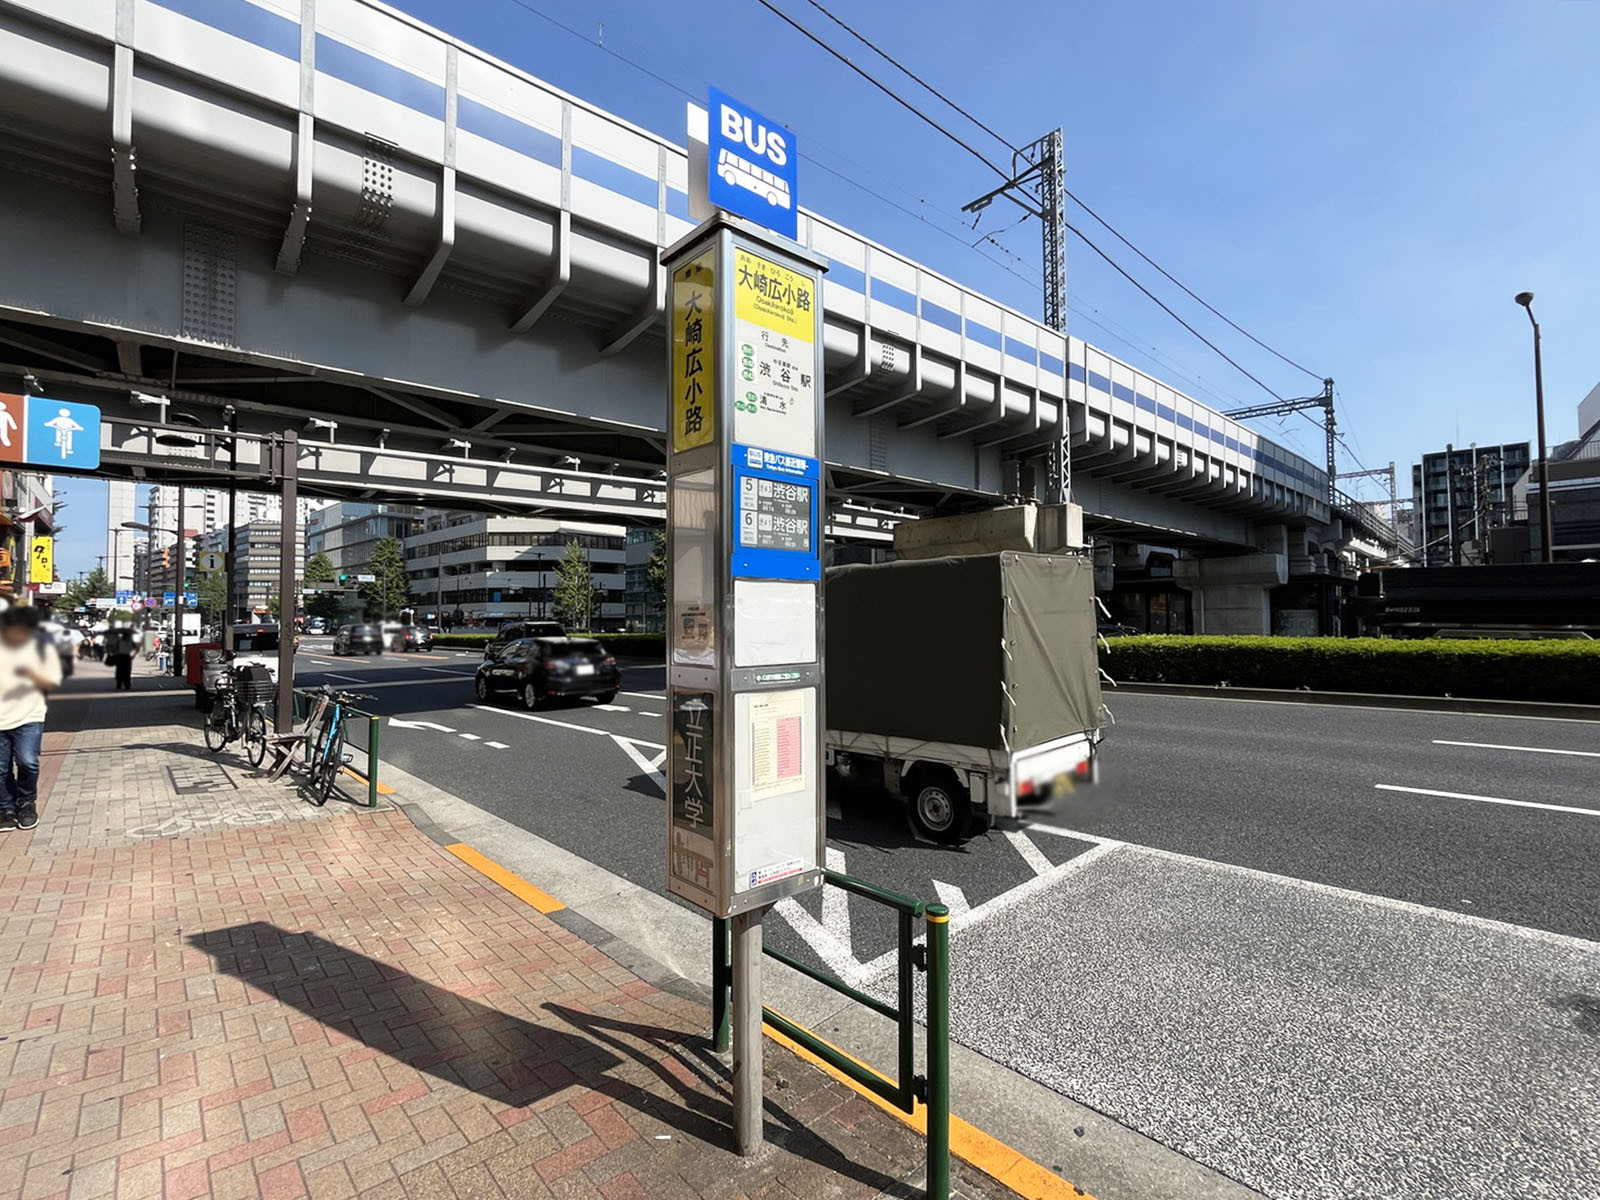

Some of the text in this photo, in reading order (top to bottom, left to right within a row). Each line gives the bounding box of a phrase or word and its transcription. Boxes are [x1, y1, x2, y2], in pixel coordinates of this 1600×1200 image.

[720, 103, 787, 166] BUS
[738, 264, 811, 312] 大崎広小路
[684, 290, 704, 437] 大崎広小路
[759, 361, 811, 389] 渋谷駅
[745, 478, 753, 491] 5
[773, 482, 809, 503] 渋谷駅
[745, 512, 753, 526] 6
[773, 516, 809, 535] 渋谷駅
[684, 708, 704, 829] 立正大学
